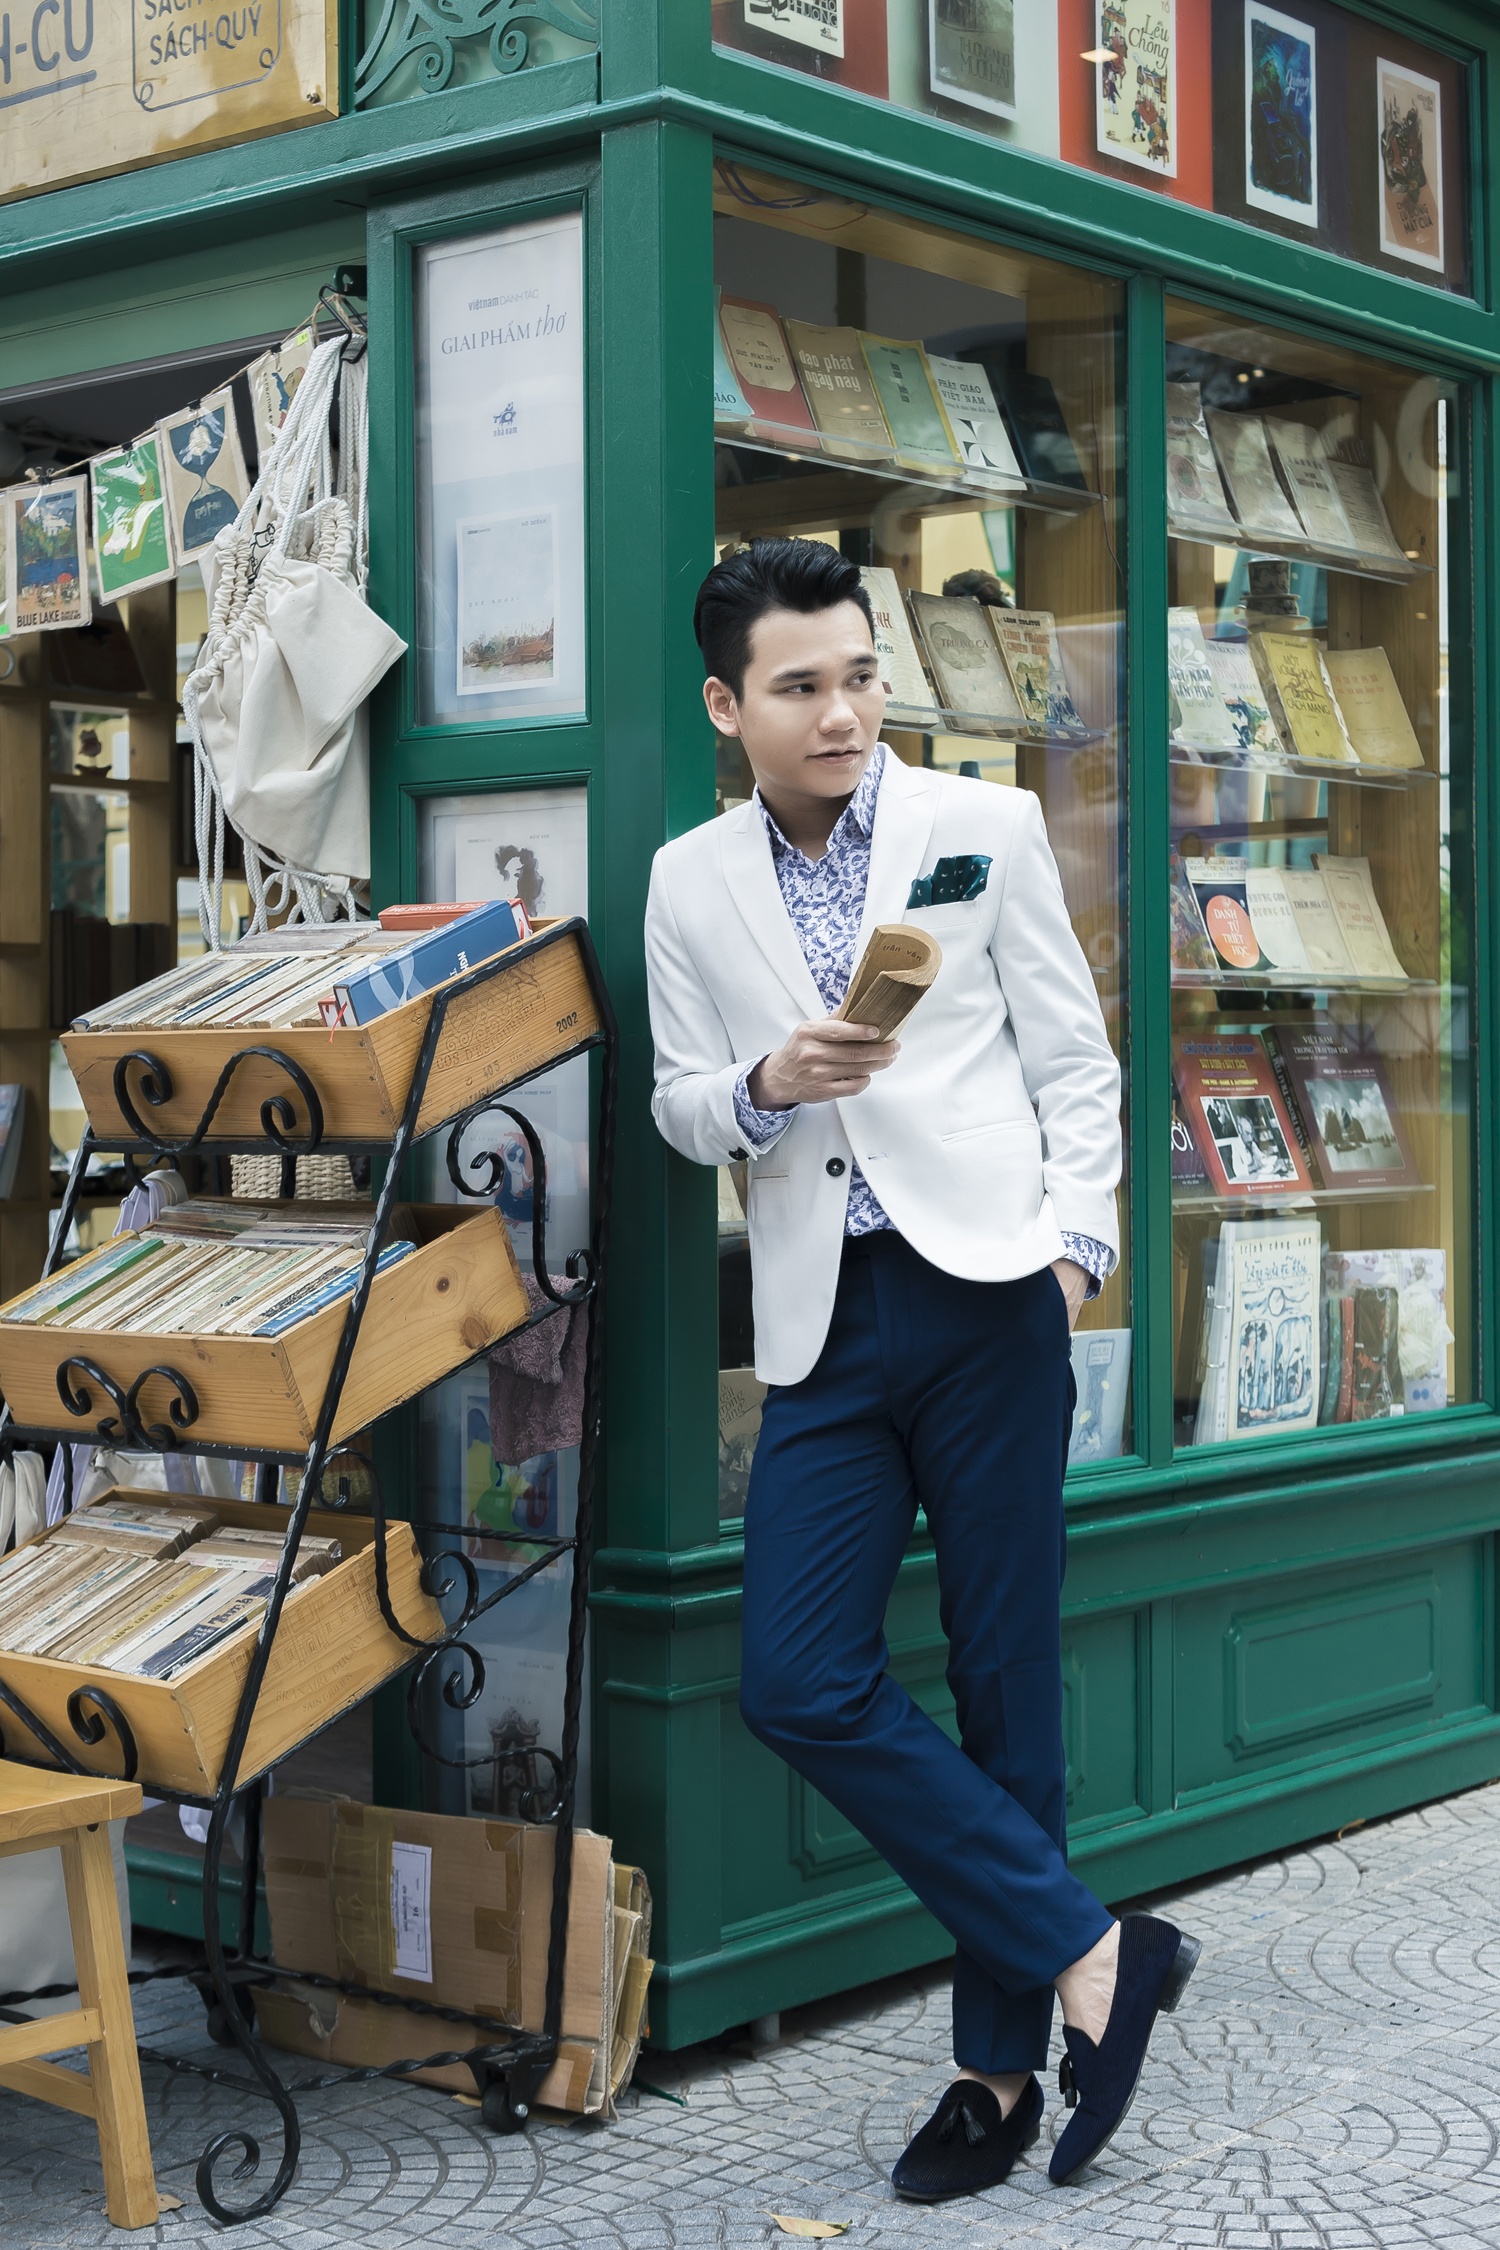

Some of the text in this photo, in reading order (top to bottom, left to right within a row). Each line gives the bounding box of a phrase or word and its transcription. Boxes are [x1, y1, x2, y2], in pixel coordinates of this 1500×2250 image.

[441, 333, 477, 355] GIAI
[834, 373, 862, 393] nay
[965, 394, 987, 405] NAM
[17, 613, 38, 628] BLUE
[39, 609, 60, 623] LAKE
[975, 639, 990, 649] CA
[1213, 908, 1238, 920] DANH
[555, 1010, 580, 1034] 2002
[436, 1051, 460, 1070] COS
